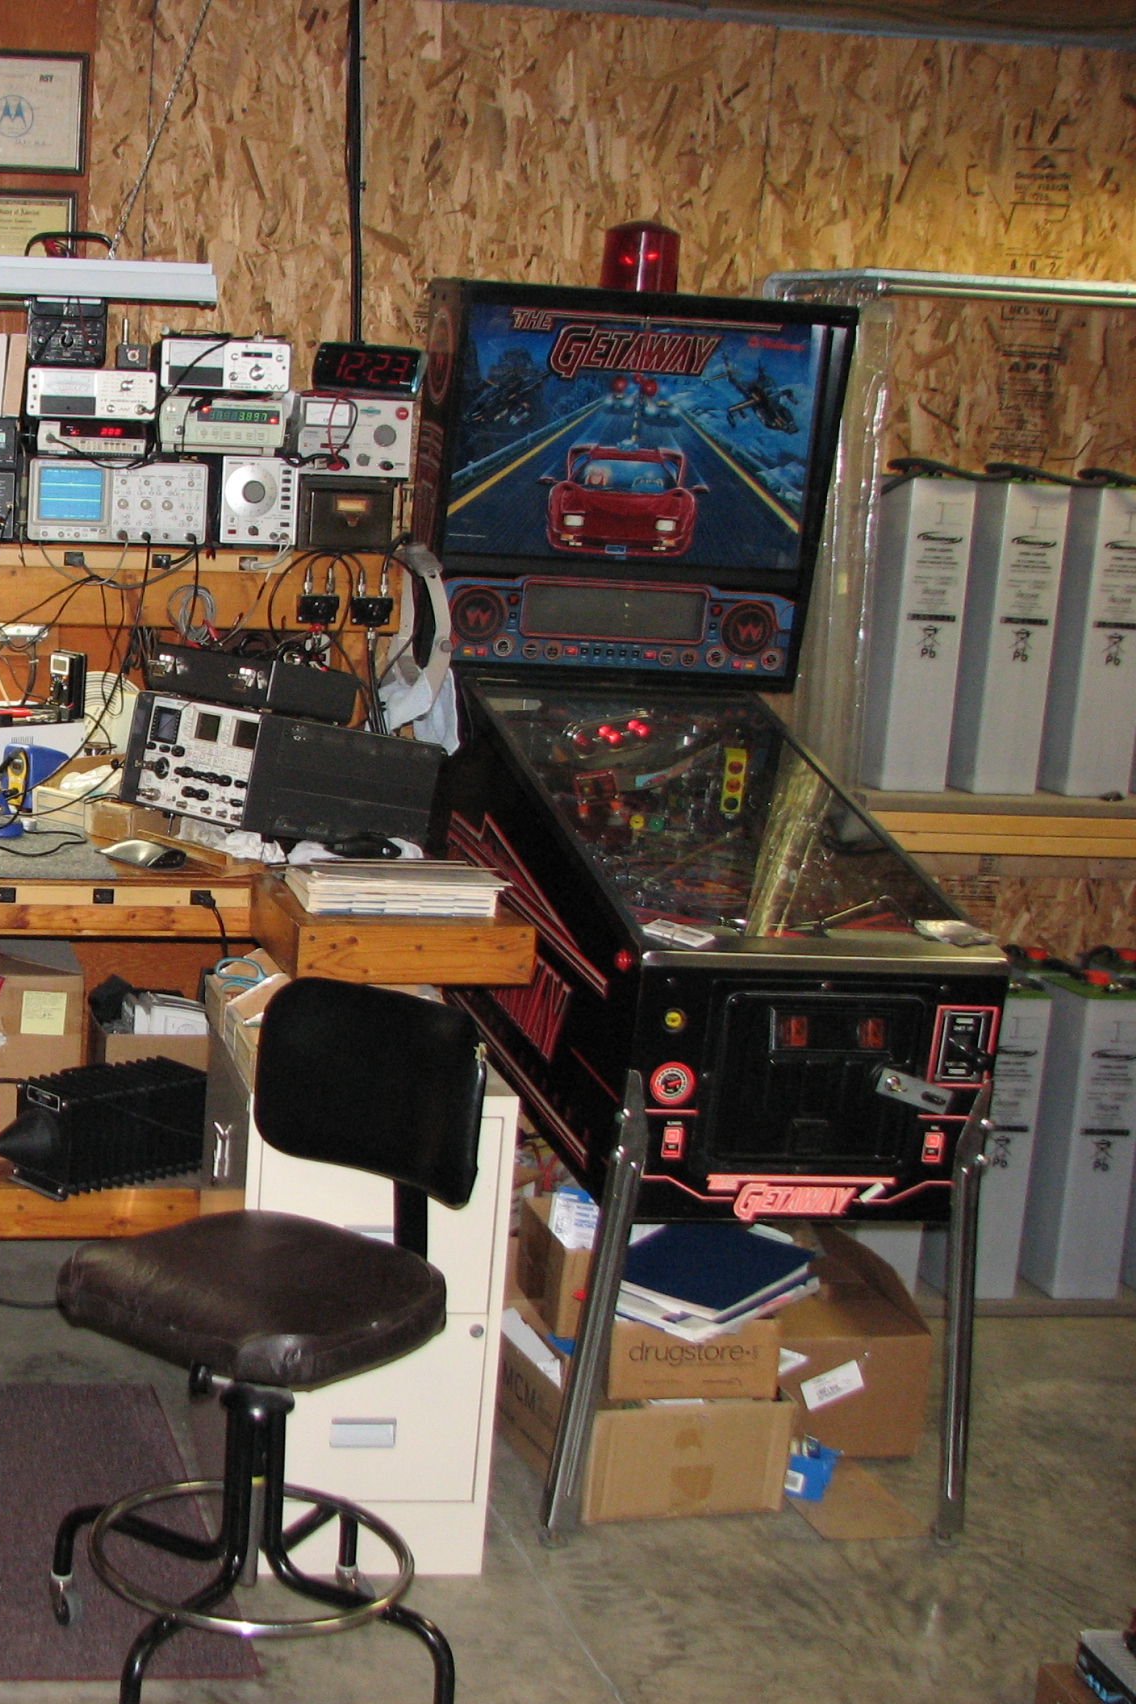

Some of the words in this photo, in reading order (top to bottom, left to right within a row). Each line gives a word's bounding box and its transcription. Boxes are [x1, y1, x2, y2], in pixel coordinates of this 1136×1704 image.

[512, 309, 554, 330] THE
[548, 323, 723, 379] GETAWAY
[335, 352, 411, 385] 12:23
[920, 647, 937, 659] Pb
[1011, 649, 1029, 662] Pb
[1104, 654, 1121, 666] Pb
[734, 1182, 858, 1223] GETAWAY
